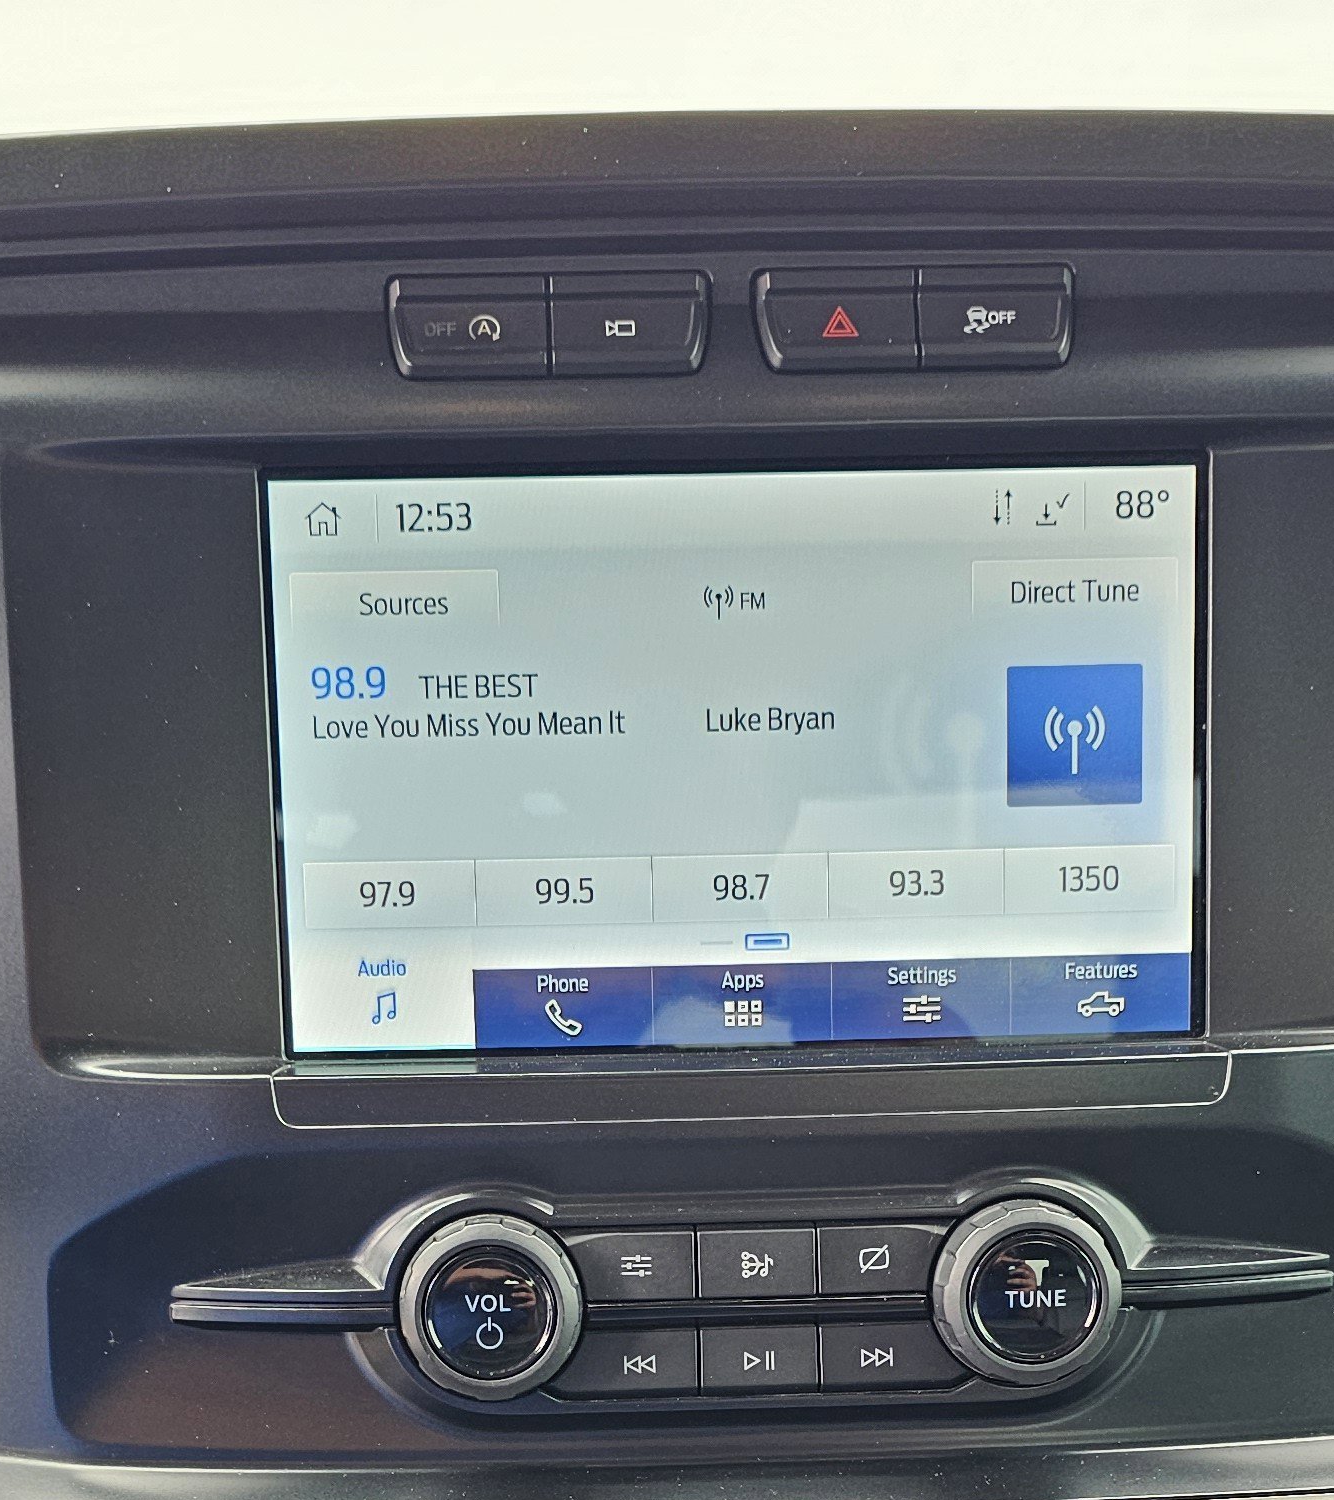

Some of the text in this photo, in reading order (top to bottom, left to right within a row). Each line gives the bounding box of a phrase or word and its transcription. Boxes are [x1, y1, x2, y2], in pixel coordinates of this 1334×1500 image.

[424, 321, 457, 337] OFF
[988, 310, 1016, 326] OFF
[1115, 489, 1170, 520] 88°
[395, 502, 473, 533] 12:53
[359, 591, 449, 617] Sources
[739, 591, 766, 610] FM
[1010, 579, 1140, 604] Direct Tune
[311, 666, 539, 701] 98.9 THE BEST
[312, 709, 626, 740] Love You Miss You Mean It
[706, 707, 836, 735] Luke Bryan
[535, 877, 595, 905] 99.5
[713, 873, 770, 901] 98.7
[888, 869, 945, 897] 93.3
[1057, 864, 1120, 893] 1350
[359, 880, 416, 908] 97.9
[357, 959, 407, 978] Audio
[887, 966, 957, 986] Settings
[1064, 962, 1139, 981] Features
[536, 974, 590, 994] Phone
[721, 971, 765, 992] Apps
[464, 1295, 512, 1314] VOL
[1004, 1288, 1067, 1309] TUNE
